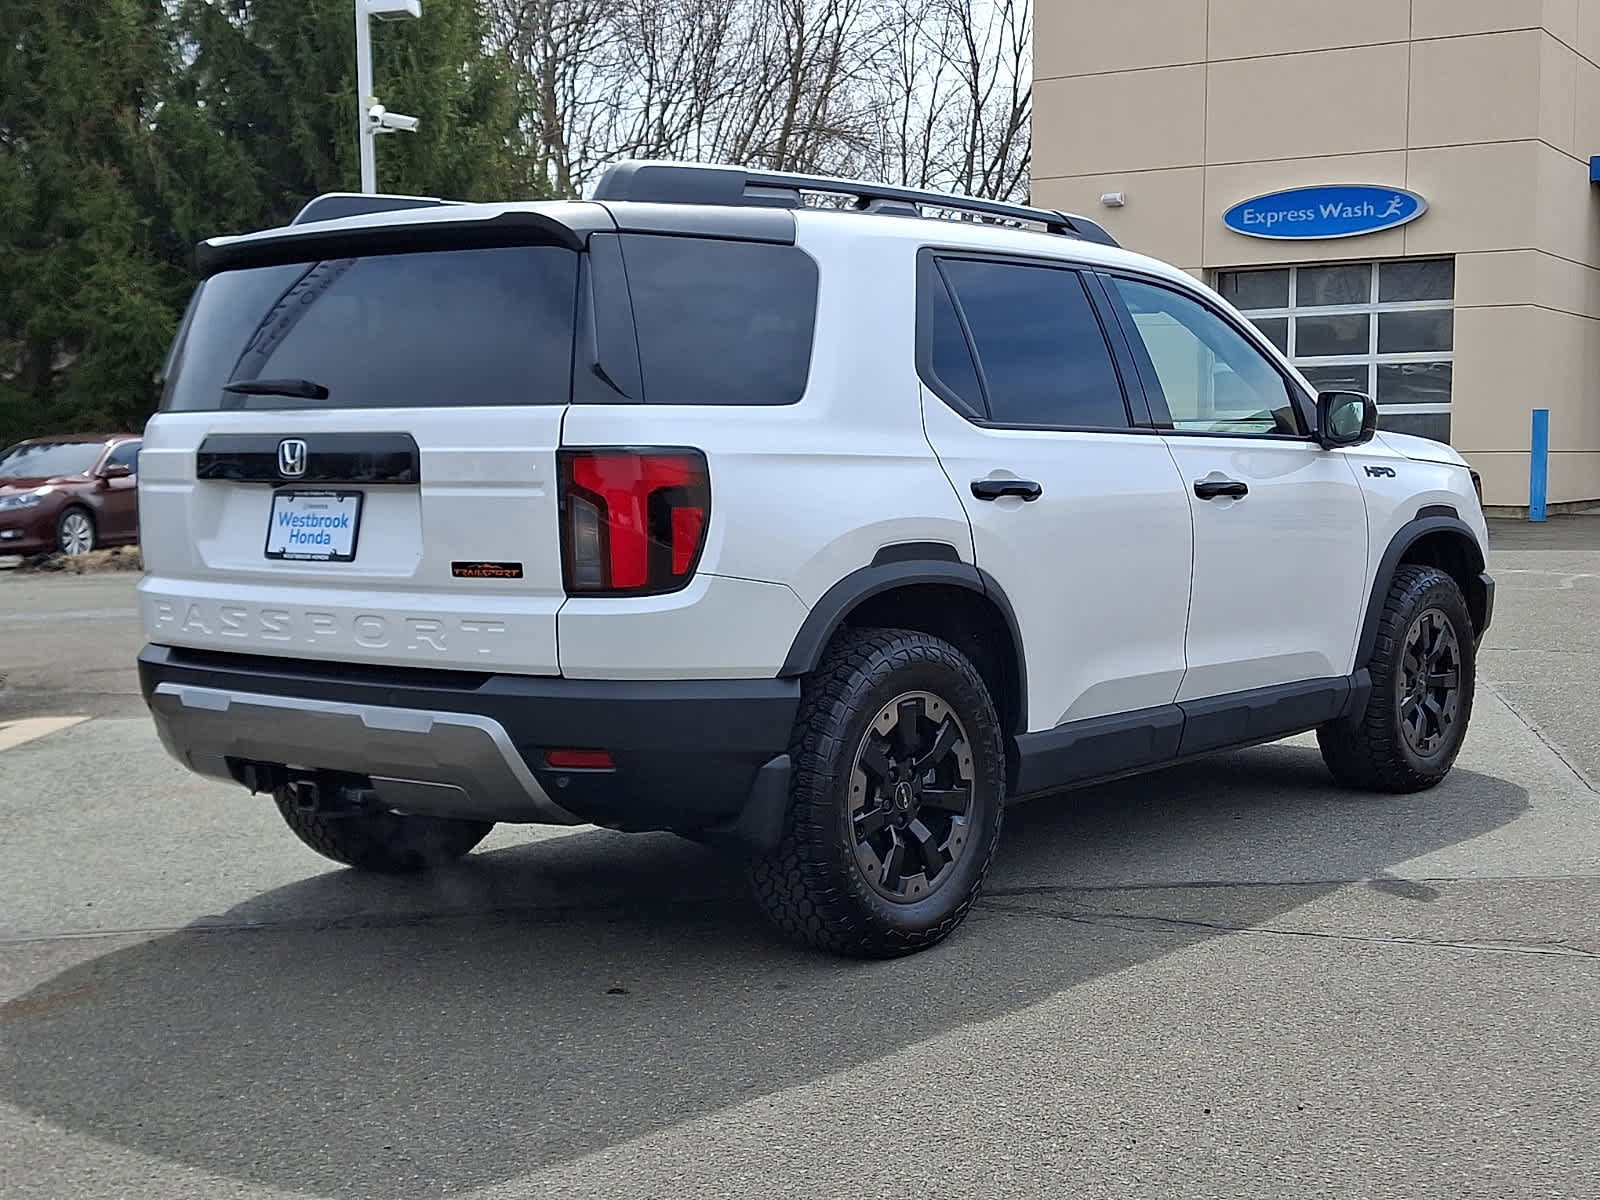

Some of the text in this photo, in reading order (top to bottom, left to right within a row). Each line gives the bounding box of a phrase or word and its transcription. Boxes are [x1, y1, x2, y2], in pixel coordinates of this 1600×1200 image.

[1243, 201, 1375, 228] Express Wash
[1363, 465, 1397, 478] HPD
[278, 511, 349, 529] Westbrook
[288, 528, 332, 545] Honda
[151, 600, 506, 654] PASSPORT
